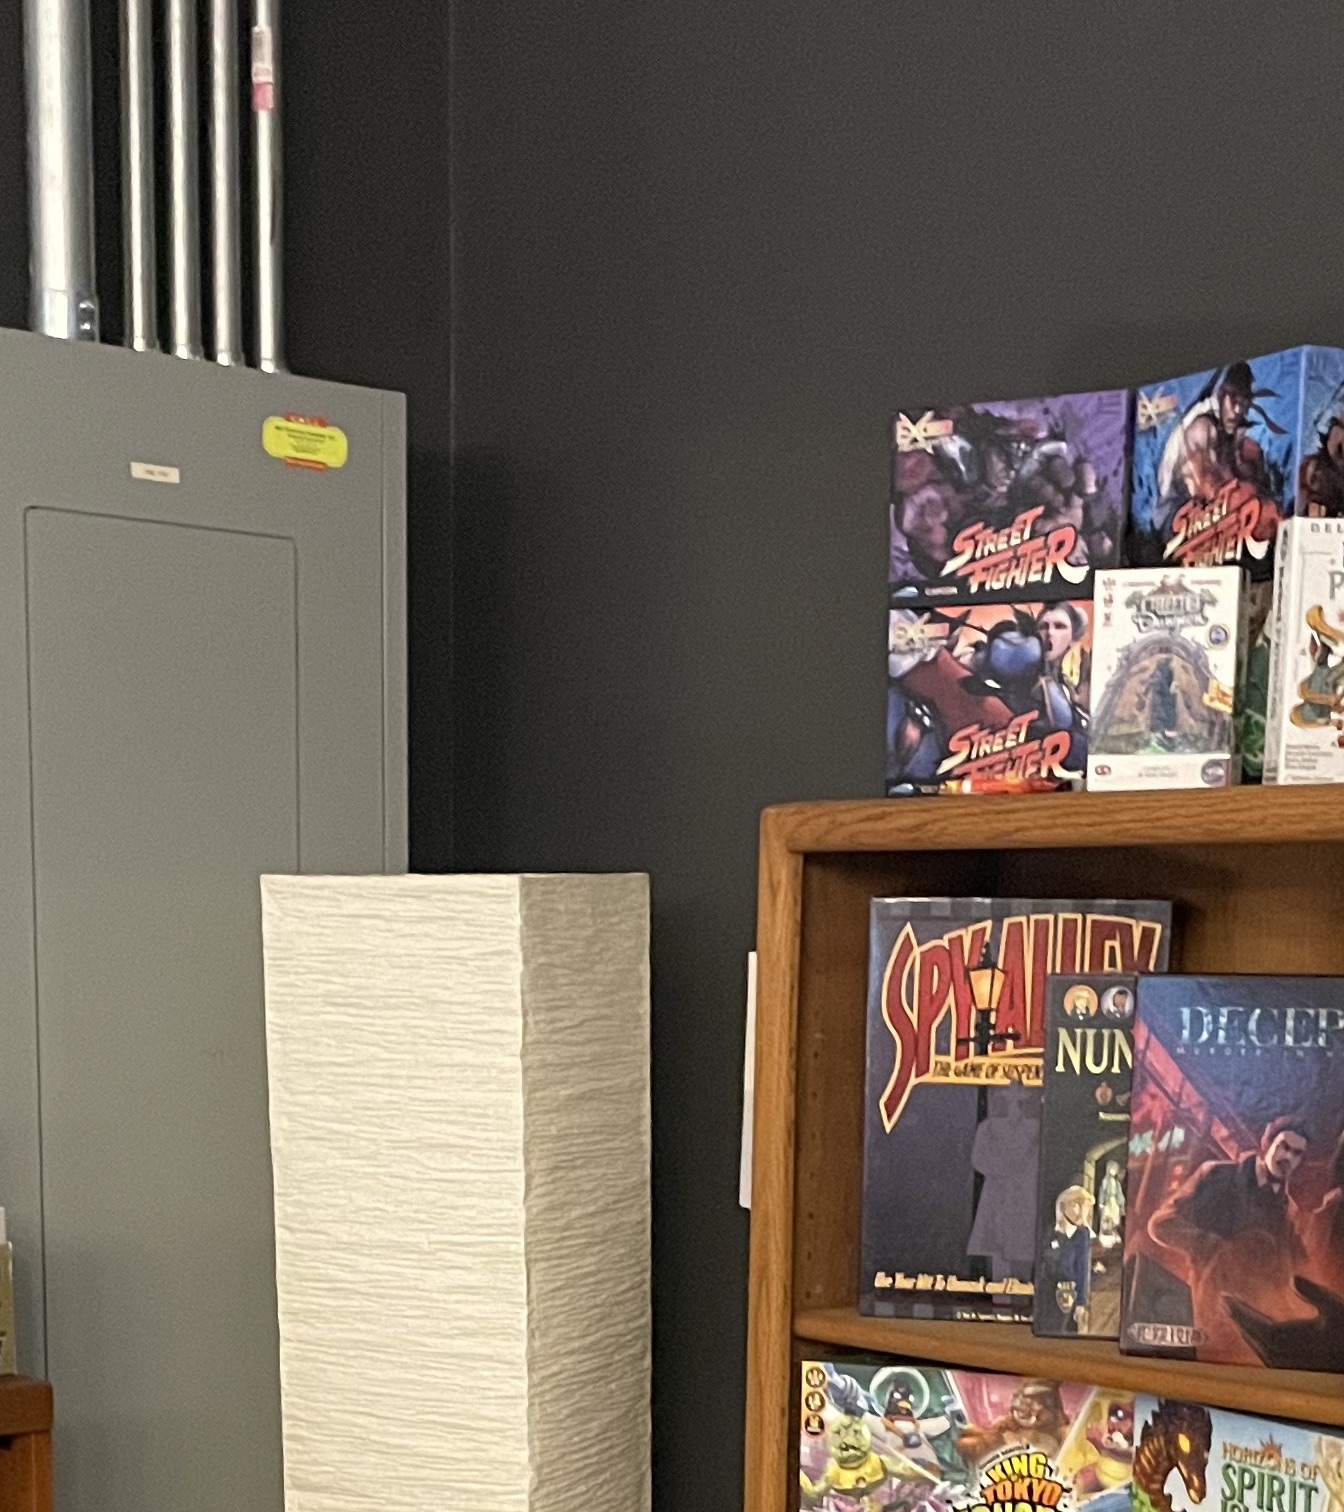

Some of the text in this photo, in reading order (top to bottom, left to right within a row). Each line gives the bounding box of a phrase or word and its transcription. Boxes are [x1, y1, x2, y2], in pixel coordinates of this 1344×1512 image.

[940, 504, 1045, 577] STREET
[956, 522, 1091, 595] FIGHTER
[936, 710, 1040, 777] STREET
[879, 918, 993, 1135] SPY
[982, 1476, 1064, 1507] TOKYO
[986, 1452, 1048, 1484] KING
